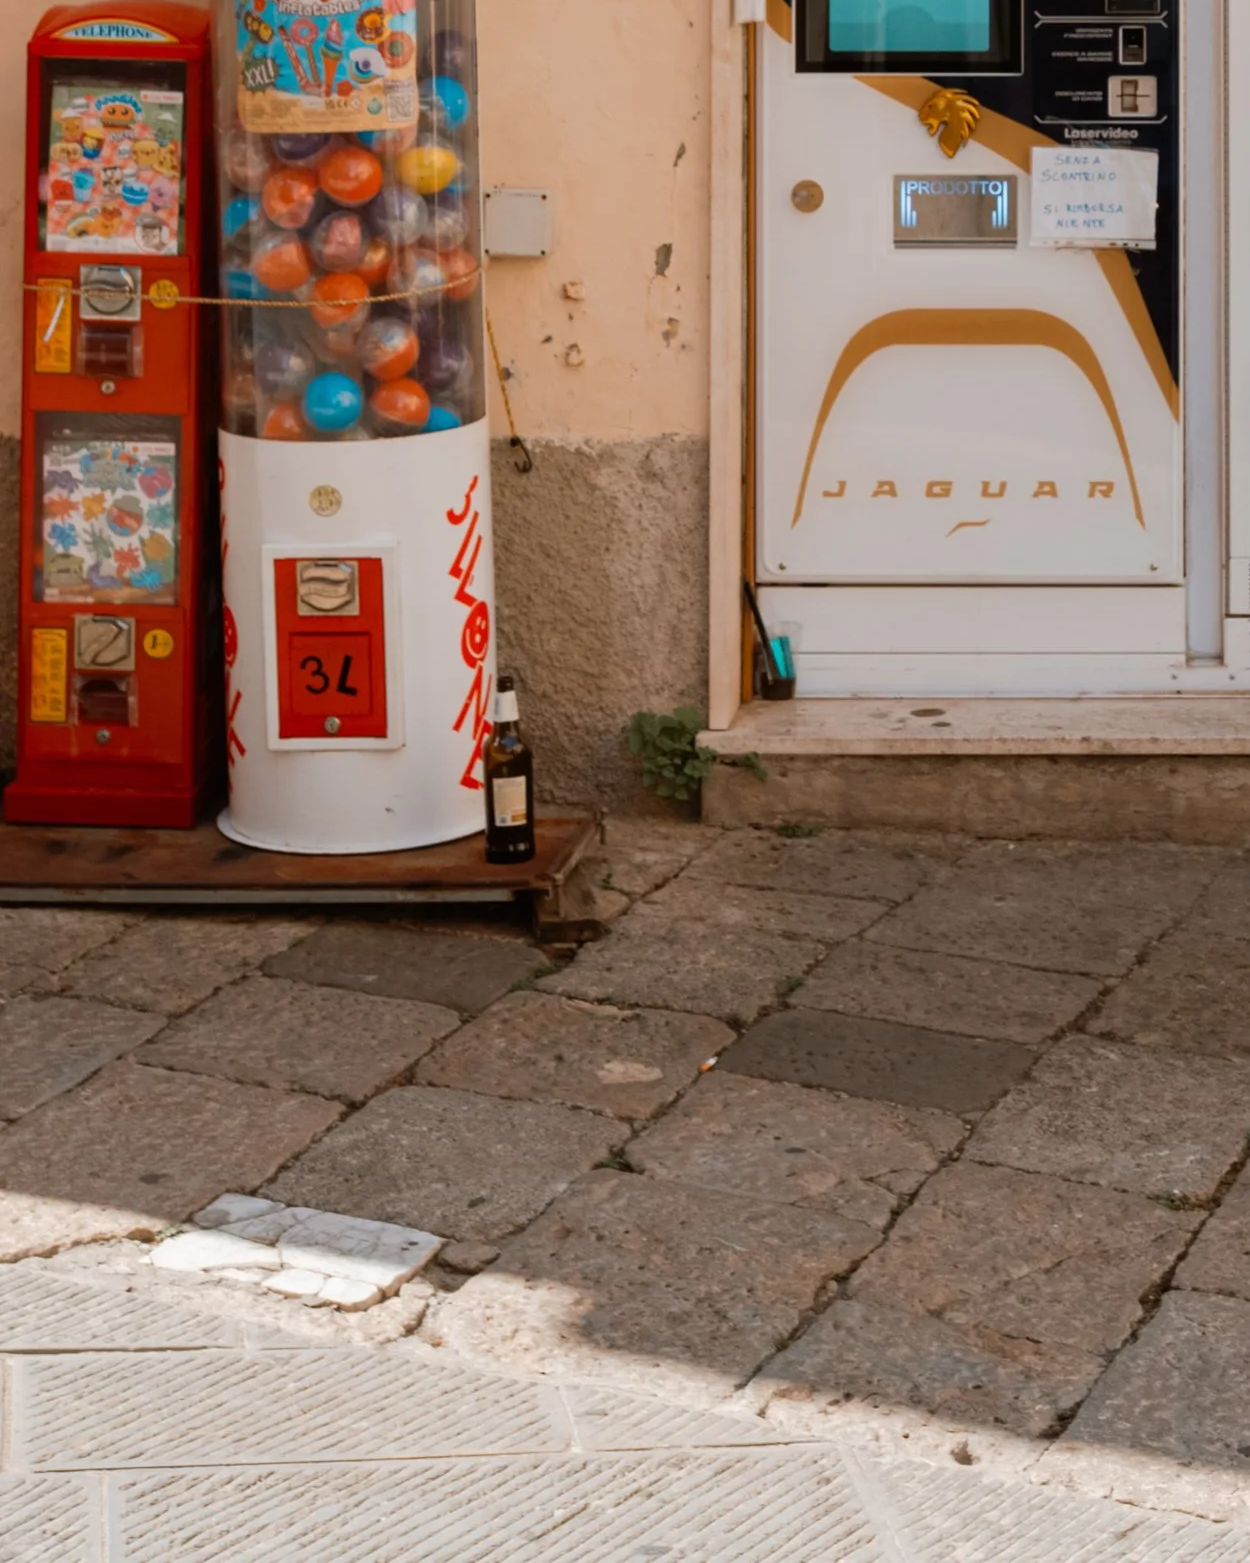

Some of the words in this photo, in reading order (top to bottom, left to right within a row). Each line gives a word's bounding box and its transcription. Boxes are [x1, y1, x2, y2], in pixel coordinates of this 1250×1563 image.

[278, 0, 361, 16] inflatables
[244, 62, 275, 87] XXL!
[1064, 127, 1138, 139] Laservideo
[906, 179, 1002, 196] PRODOTTO
[822, 480, 1116, 499] JAGUAR
